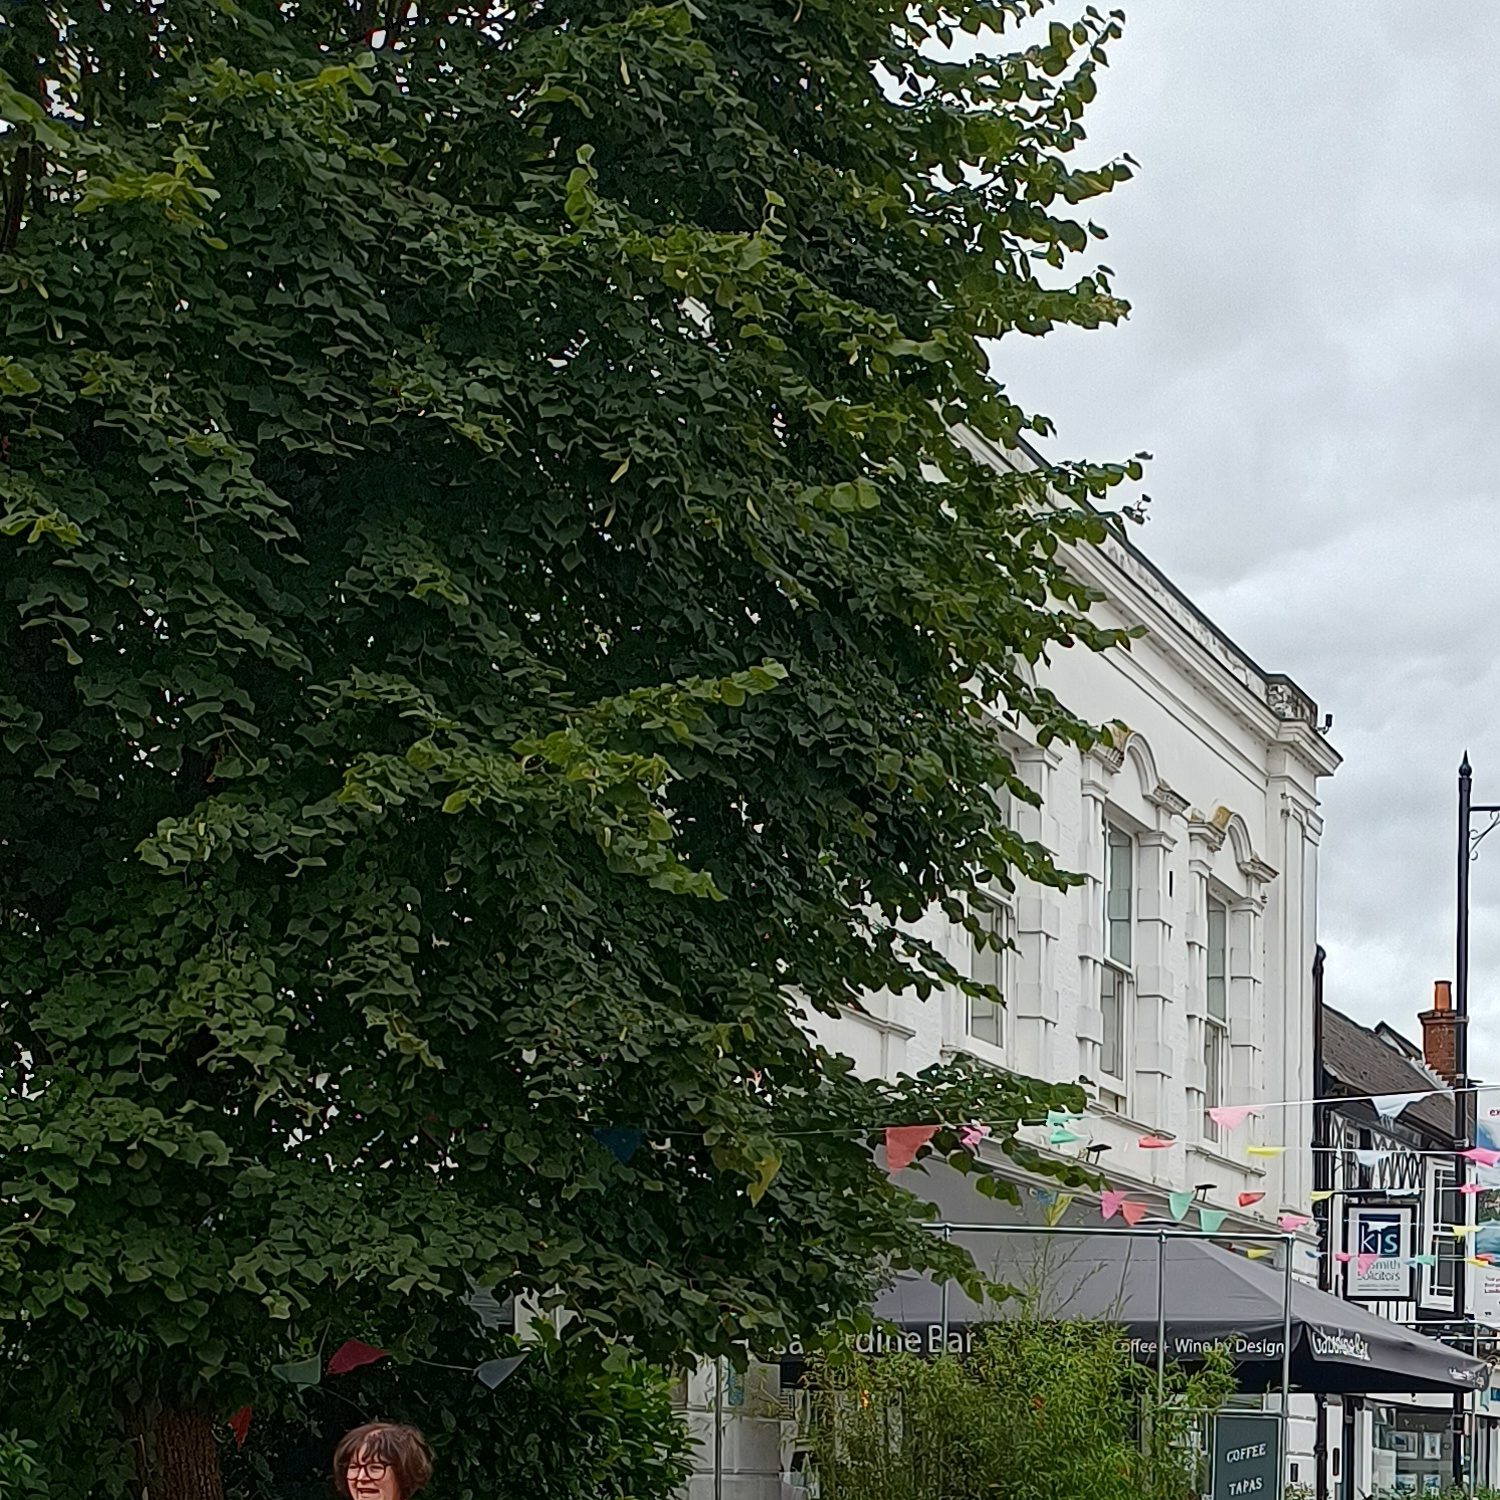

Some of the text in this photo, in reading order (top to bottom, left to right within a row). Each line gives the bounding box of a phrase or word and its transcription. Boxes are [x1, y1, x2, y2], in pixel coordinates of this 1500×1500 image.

[928, 1324, 977, 1354] Bar
[1174, 1338, 1211, 1353] Wine
[1235, 1339, 1285, 1357] Design
[1226, 1443, 1267, 1464] COFFEE
[1228, 1477, 1263, 1496] TAPAS
